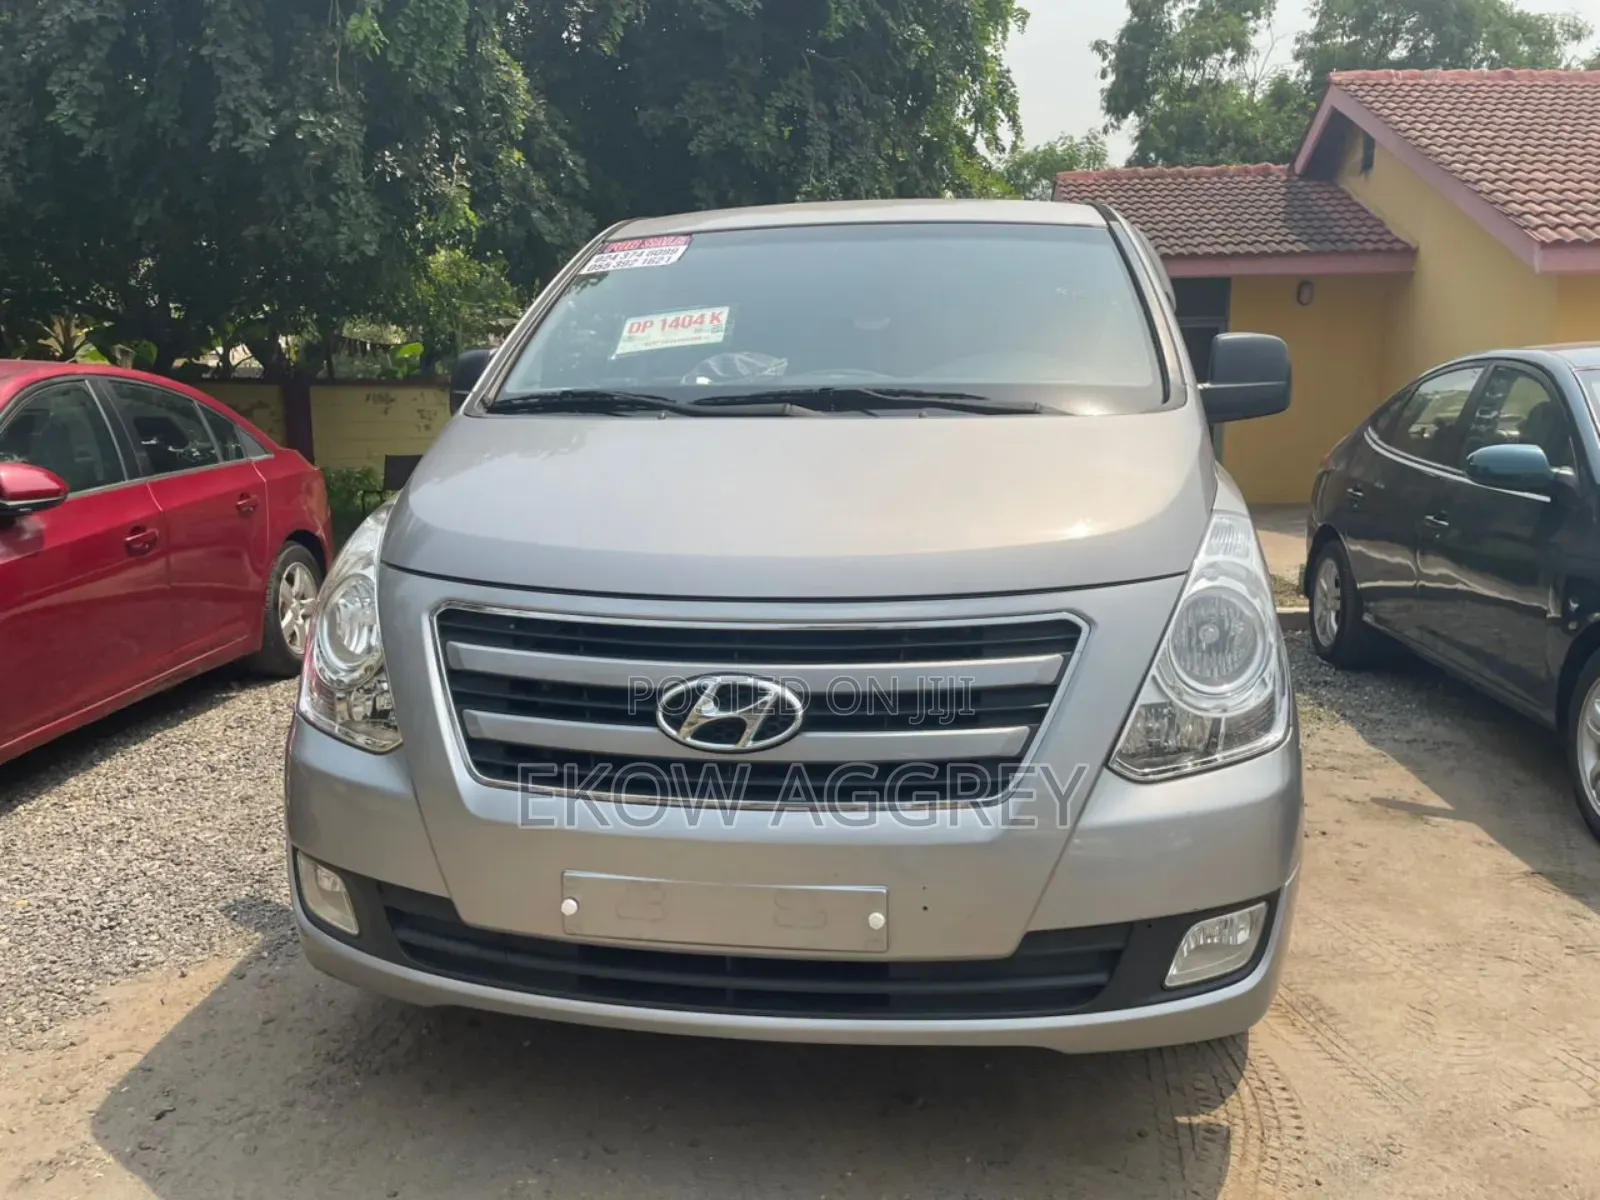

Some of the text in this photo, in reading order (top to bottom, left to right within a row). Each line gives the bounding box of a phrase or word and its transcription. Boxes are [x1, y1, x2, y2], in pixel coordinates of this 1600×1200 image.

[627, 319, 654, 335] DP
[659, 312, 706, 331] 1404
[708, 311, 724, 325] K
